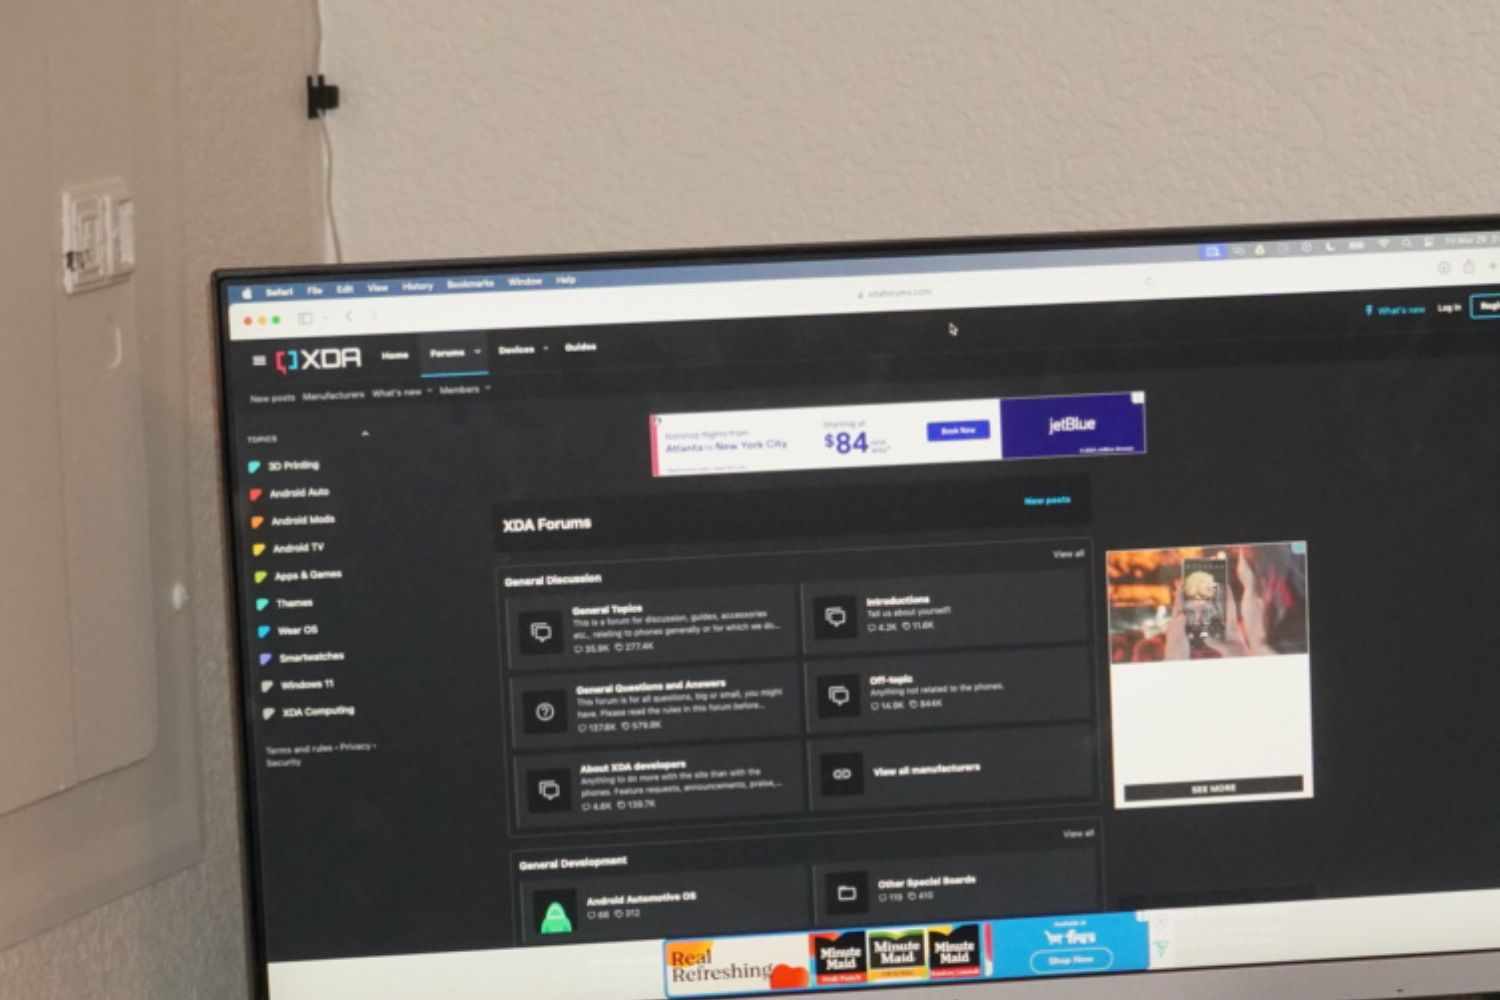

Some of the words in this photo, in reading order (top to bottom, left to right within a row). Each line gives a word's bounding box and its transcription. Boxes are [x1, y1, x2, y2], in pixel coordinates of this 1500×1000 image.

[266, 286, 293, 297] Safari
[307, 285, 323, 295] File
[336, 284, 354, 294] Edit
[367, 282, 389, 293] View
[402, 280, 434, 292] History
[447, 278, 494, 289] Bookmarks
[508, 276, 543, 287] Window
[556, 274, 577, 286] Help
[381, 350, 409, 360] Home
[429, 347, 466, 359] Forums
[498, 345, 535, 356] Devices
[565, 342, 597, 352] Guides
[301, 347, 362, 370] XDA
[251, 394, 269, 404] New
[270, 394, 296, 406] posts
[302, 391, 365, 401] Manufacturers
[372, 388, 402, 398] What's
[439, 385, 480, 395] Members
[1048, 416, 1096, 436] jetBlue
[666, 443, 703, 454] Atlanta
[715, 442, 738, 451] New
[741, 440, 764, 450] York
[766, 439, 788, 450] City
[824, 431, 869, 455] $84
[284, 460, 320, 472] Printing
[270, 488, 305, 499] Android
[308, 487, 330, 497] Auto
[1024, 496, 1044, 506] New
[1046, 496, 1072, 506] posts
[272, 516, 307, 526] Android
[310, 514, 336, 524] Mods
[503, 519, 535, 533] XDA
[537, 517, 592, 532] Forums
[273, 543, 308, 554] Android
[312, 542, 325, 552] TV
[1053, 550, 1072, 559] View
[275, 570, 299, 582] Apps
[310, 569, 343, 579] Games
[504, 575, 544, 587] General
[546, 572, 602, 585] Discussion
[277, 598, 313, 608] Themes
[866, 595, 931, 607] Introductions
[572, 605, 610, 616] General
[611, 603, 643, 616] Topics
[278, 626, 302, 636] Wear
[304, 625, 319, 635] OS
[280, 651, 345, 663] Smartwatches
[281, 679, 323, 690] Windows
[576, 684, 613, 696] General
[615, 681, 664, 695] Questions
[665, 681, 683, 692] and
[685, 679, 726, 690] Answers
[282, 707, 303, 718] XDA
[305, 705, 355, 717] Computing
[580, 762, 609, 773] About
[611, 761, 632, 772] XDA
[634, 759, 686, 773] developers
[873, 766, 896, 777] View
[911, 762, 981, 776] manufacturers
[1191, 785, 1208, 794] SEE
[1209, 783, 1237, 793] MORE
[519, 859, 559, 871] General
[560, 855, 628, 869] Development
[878, 879, 905, 889] Other
[906, 877, 941, 888] Special
[943, 875, 976, 886] Boards
[587, 896, 625, 907] Android
[627, 892, 680, 904] Automotive
[682, 891, 697, 901] OS
[820, 946, 862, 959] Minute
[874, 940, 921, 954] Minute
[934, 940, 975, 954] Minute
[671, 948, 713, 967] Real
[826, 958, 857, 971] Maid
[881, 951, 917, 965] Maid
[940, 951, 970, 965] Maid
[672, 962, 775, 983] Refreshing
